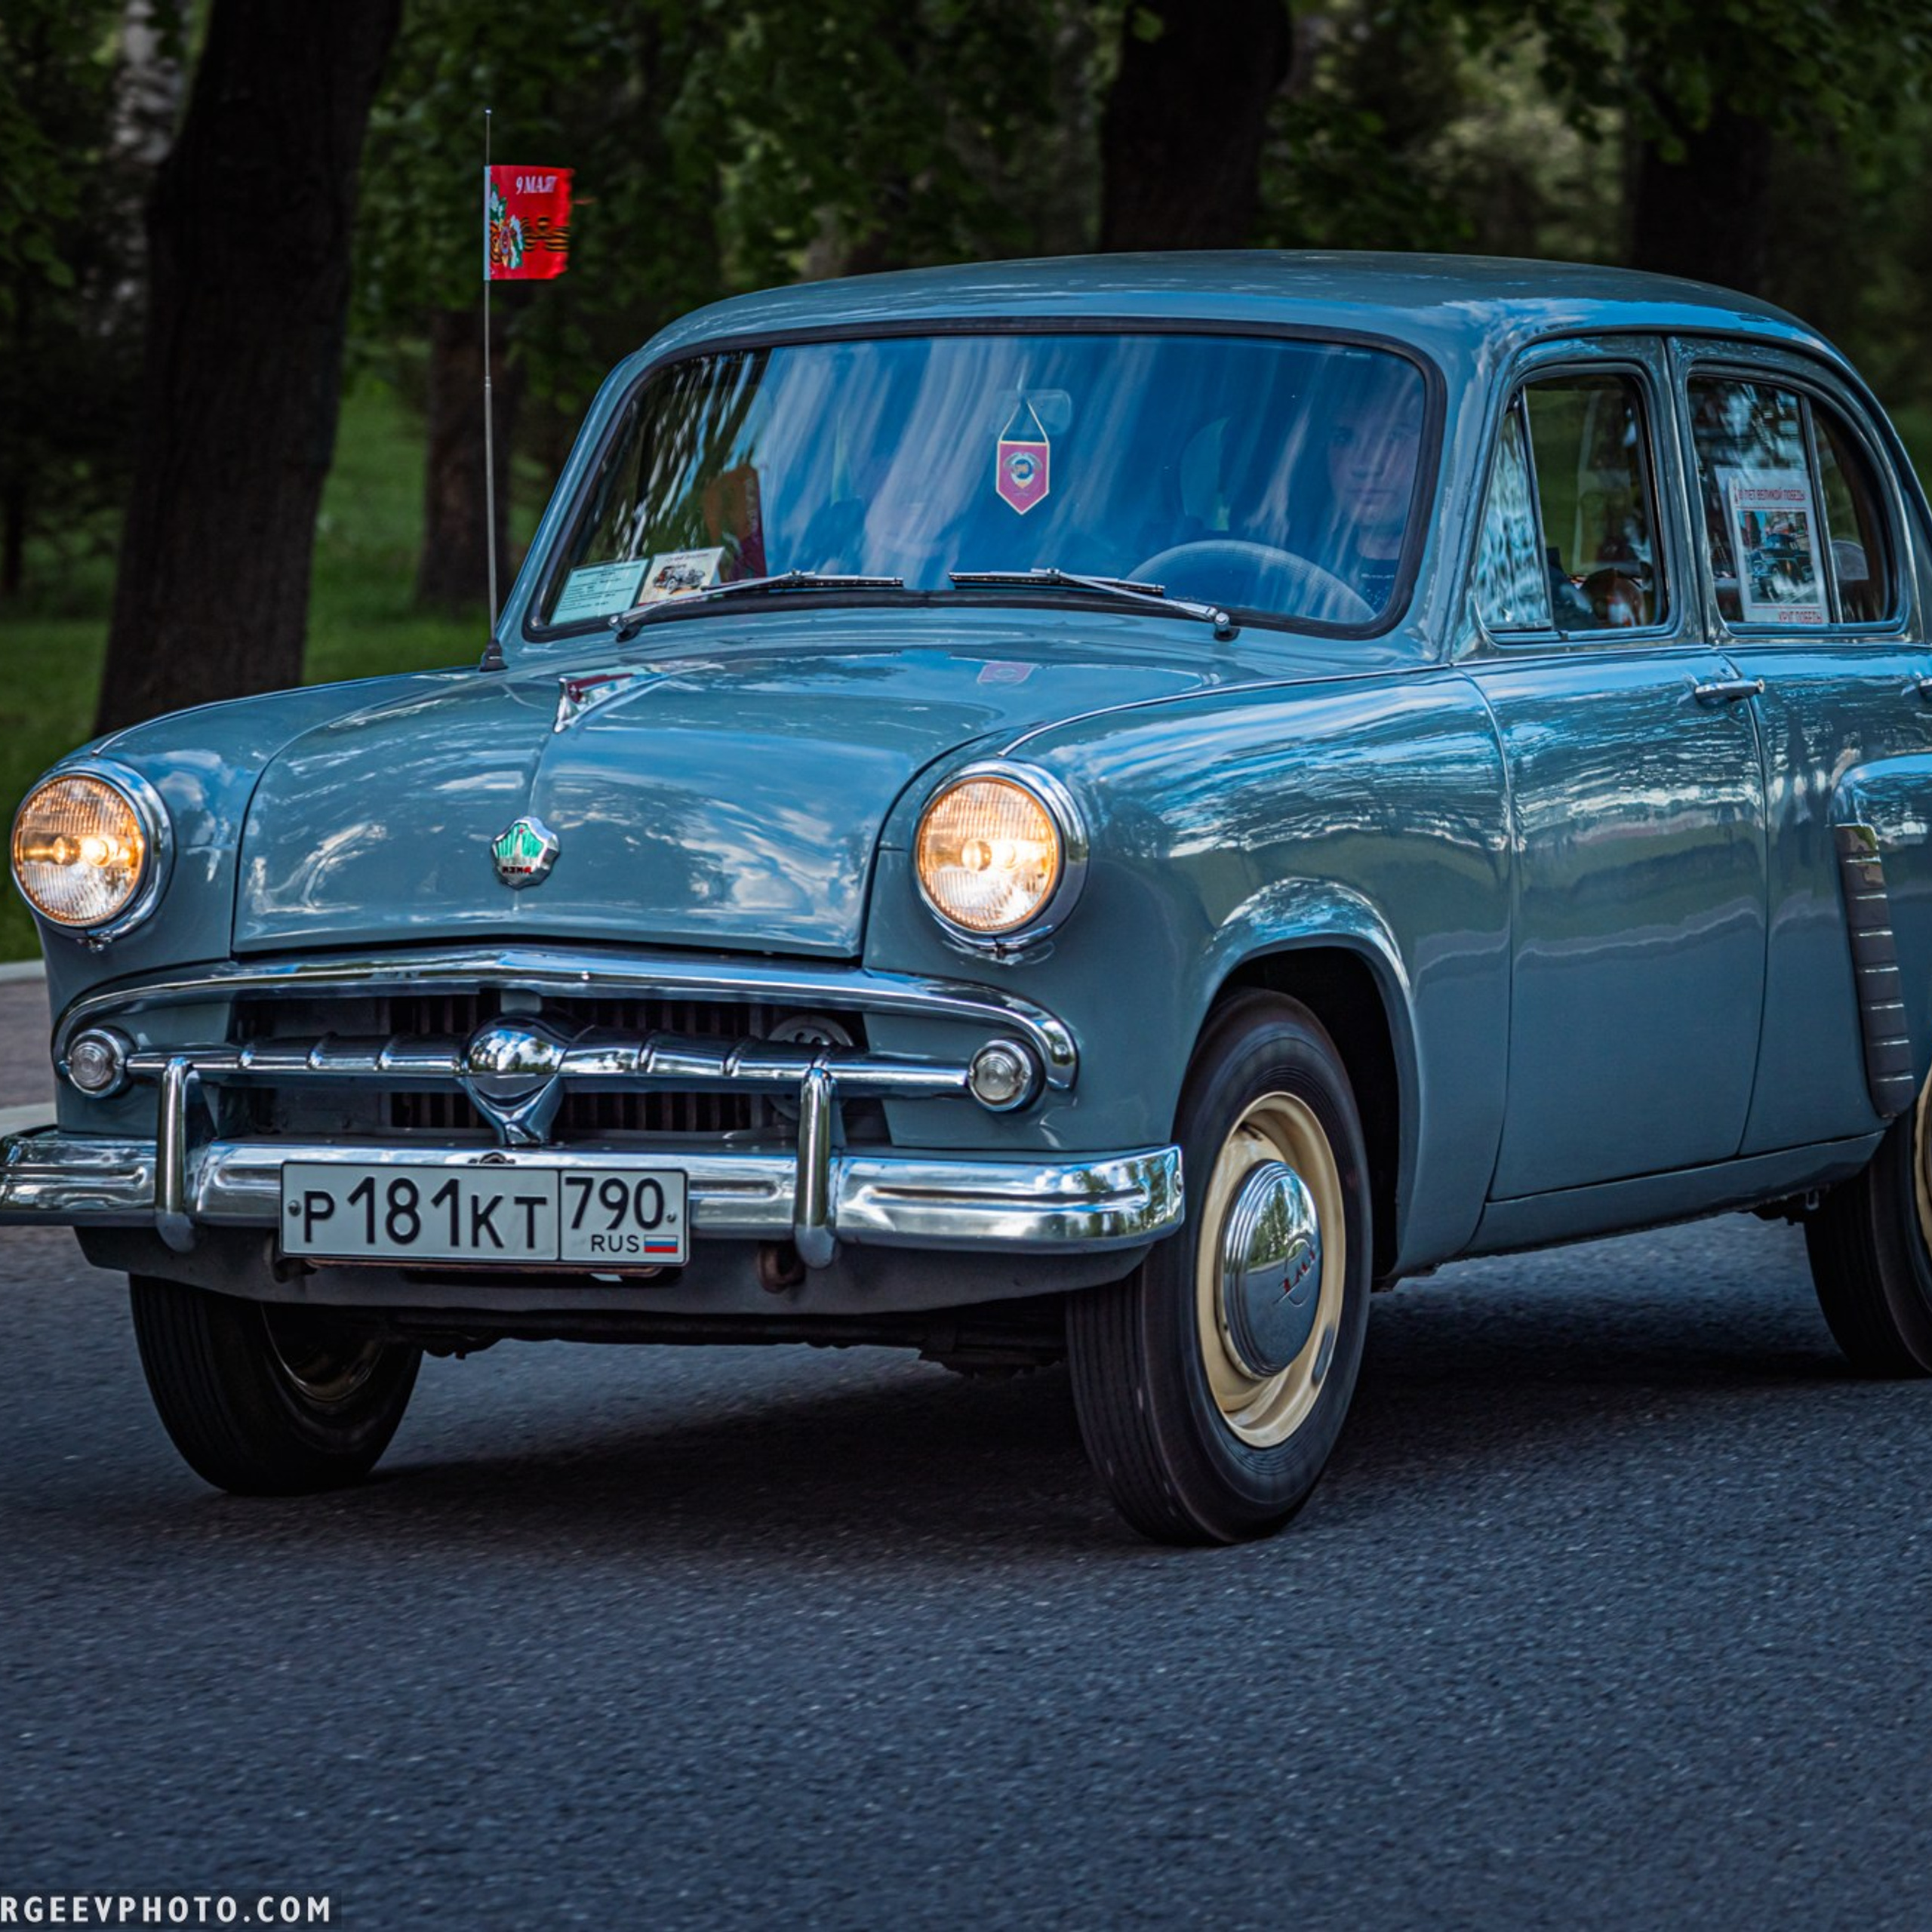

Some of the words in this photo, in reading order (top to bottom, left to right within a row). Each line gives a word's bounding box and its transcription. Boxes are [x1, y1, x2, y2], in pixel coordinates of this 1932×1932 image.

[515, 176, 524, 195] 9
[523, 175, 558, 194] МАЯ
[565, 1177, 665, 1230] 790
[591, 1235, 639, 1253] RUS
